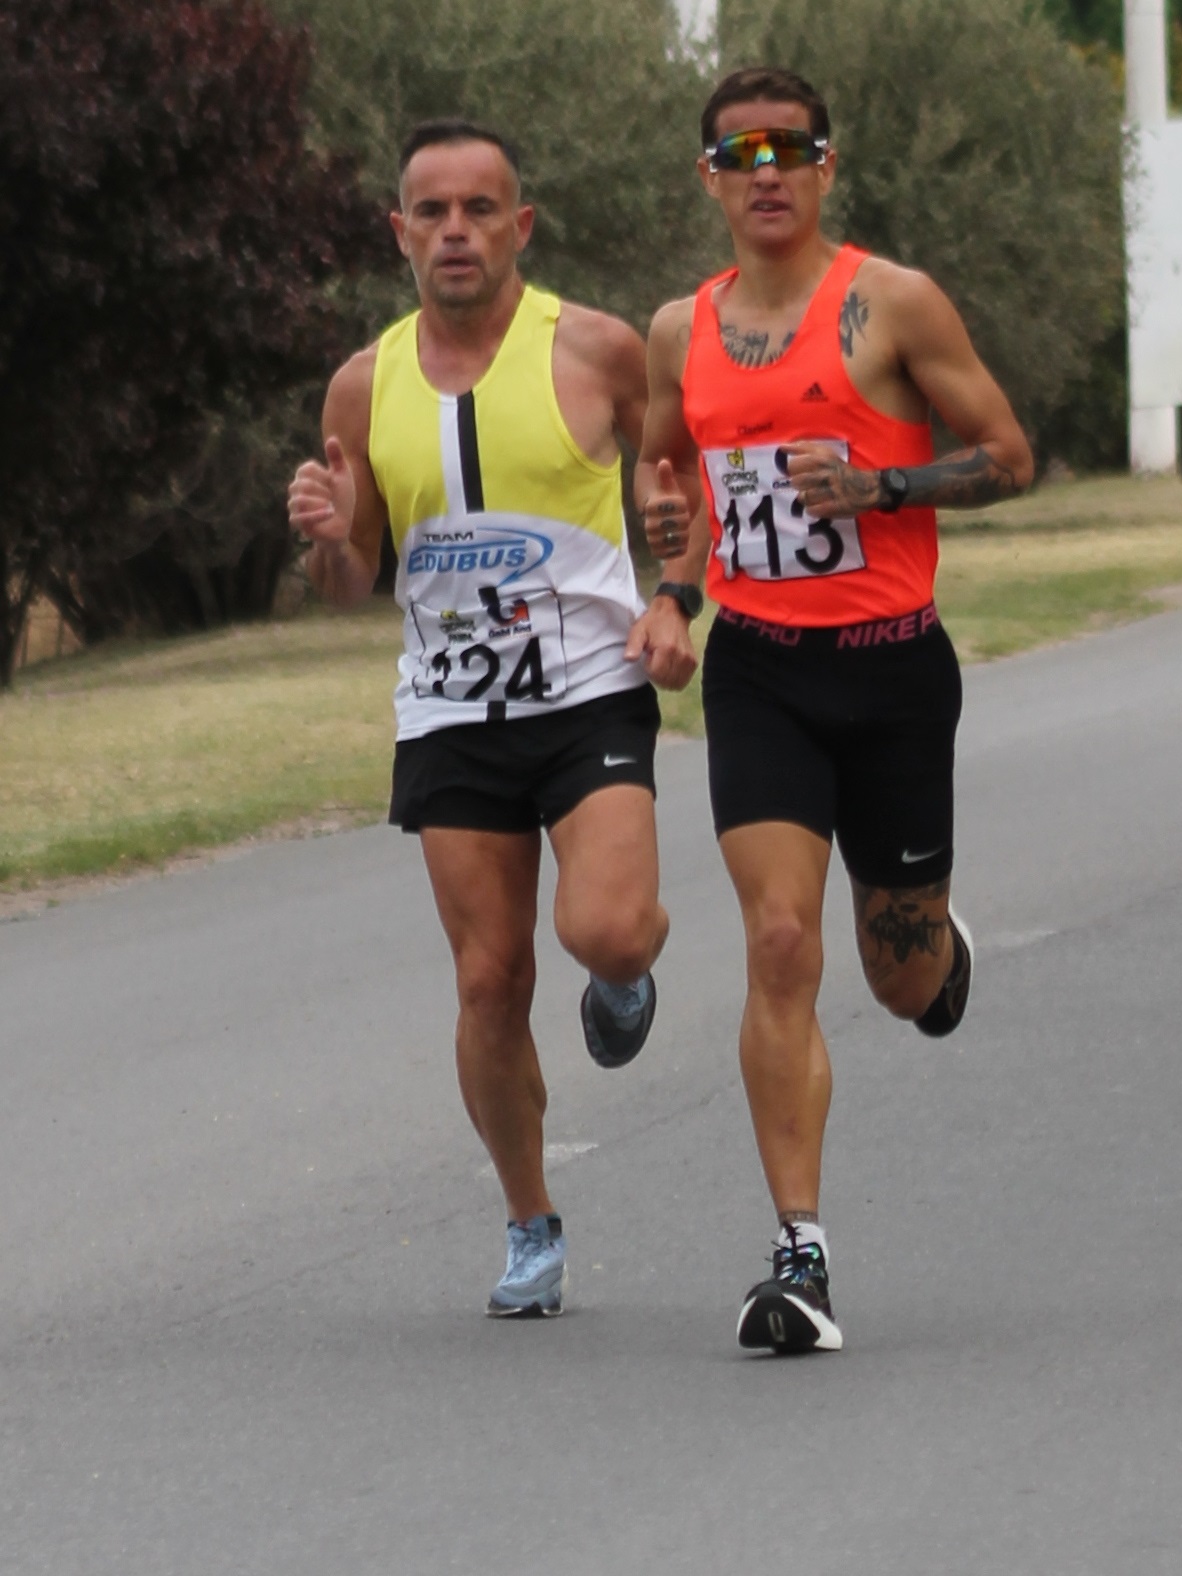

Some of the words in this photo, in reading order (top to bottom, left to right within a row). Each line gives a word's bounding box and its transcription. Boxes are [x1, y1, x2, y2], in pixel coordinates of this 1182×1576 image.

[424, 531, 474, 542] TEAM
[723, 494, 844, 578] 113
[408, 547, 526, 575] EDUBUS
[837, 613, 917, 649] NIKE
[431, 636, 553, 701] 124
